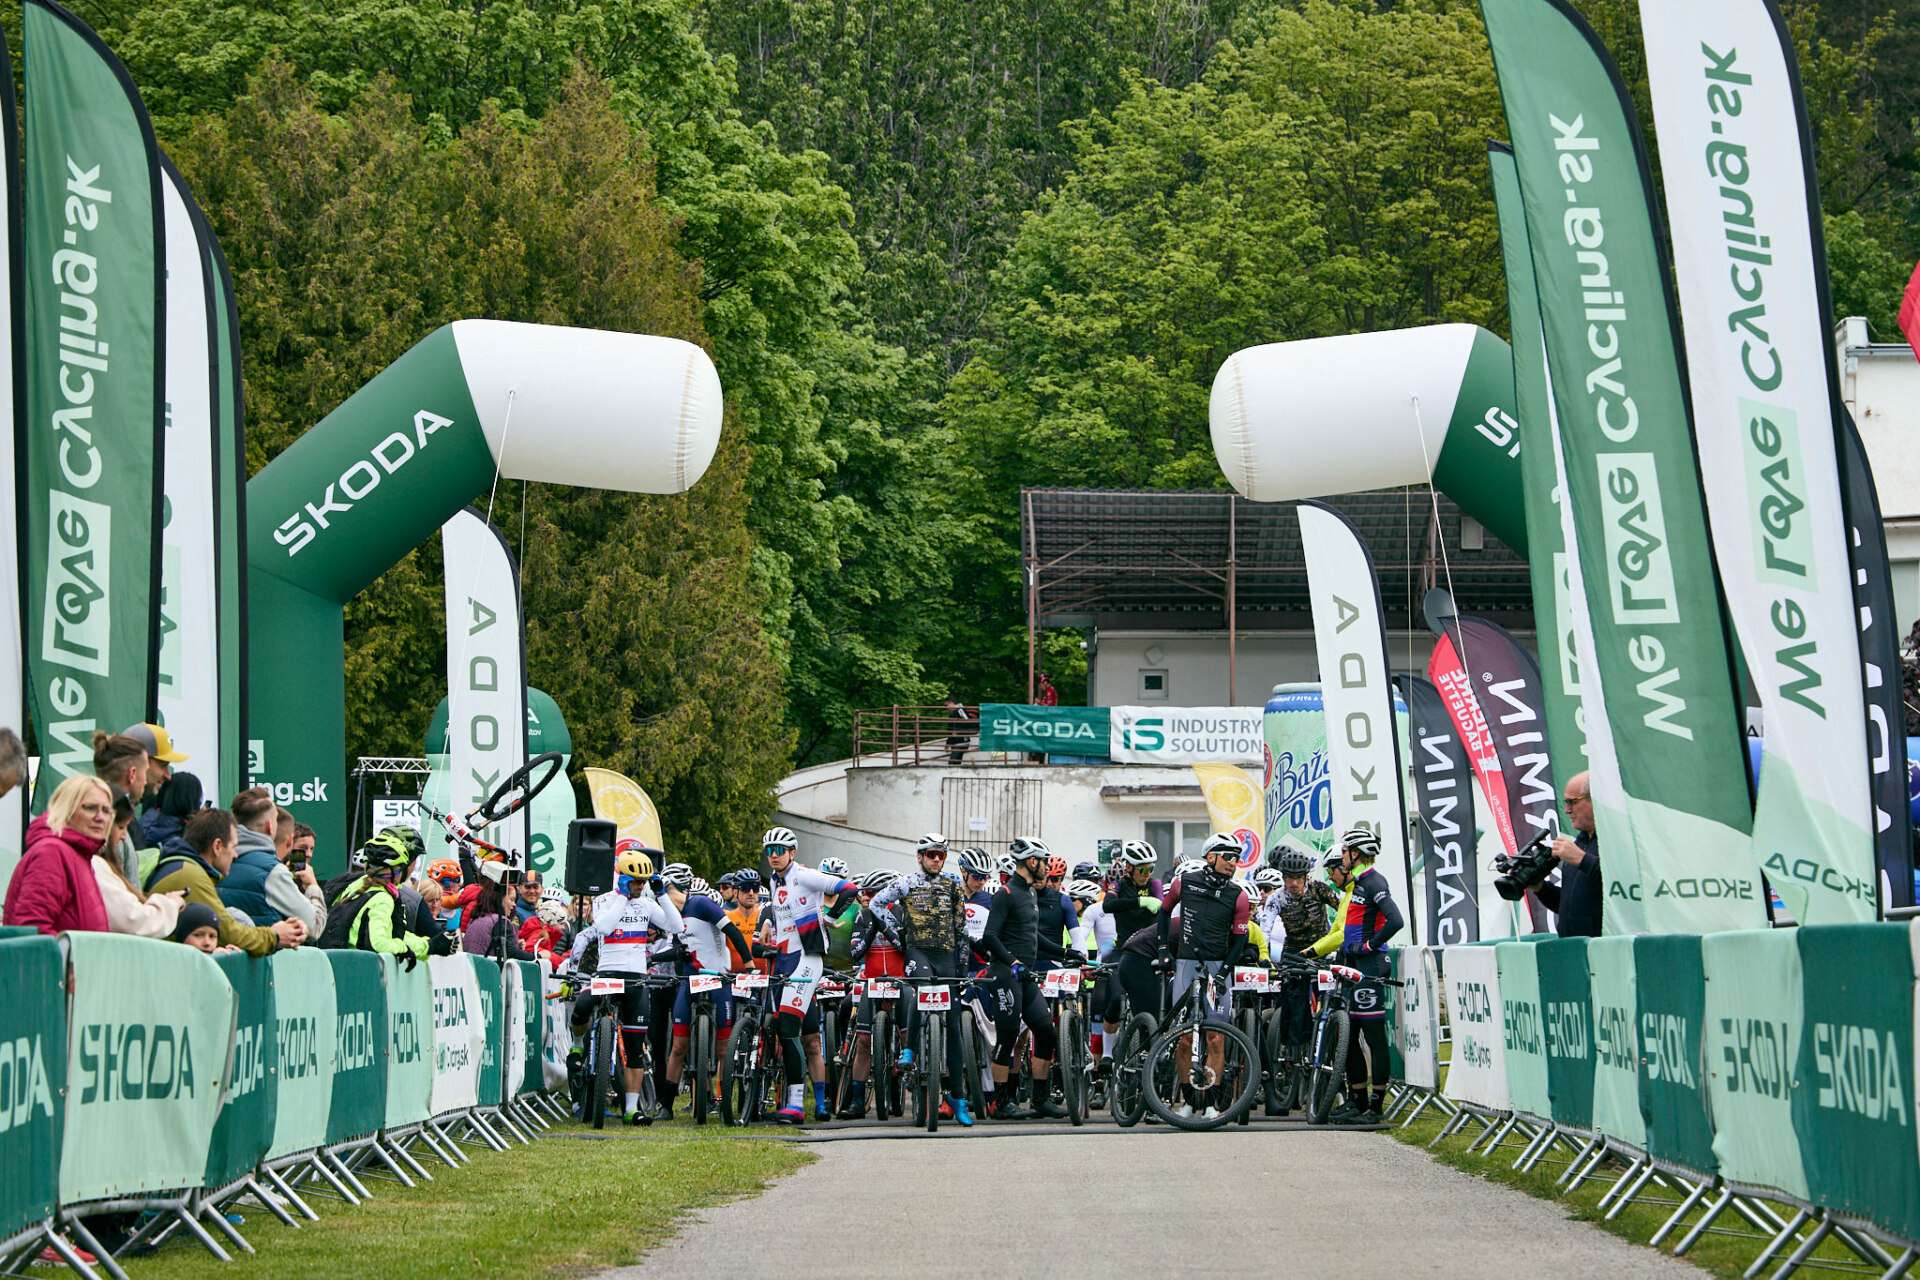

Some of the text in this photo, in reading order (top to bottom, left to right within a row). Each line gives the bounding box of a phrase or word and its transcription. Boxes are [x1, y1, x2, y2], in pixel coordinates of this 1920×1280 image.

[1171, 719, 1262, 735] INDUSTRY
[1171, 738, 1262, 753] SOLUTION
[1242, 973, 1260, 983] 62
[925, 993, 943, 1004] 44
